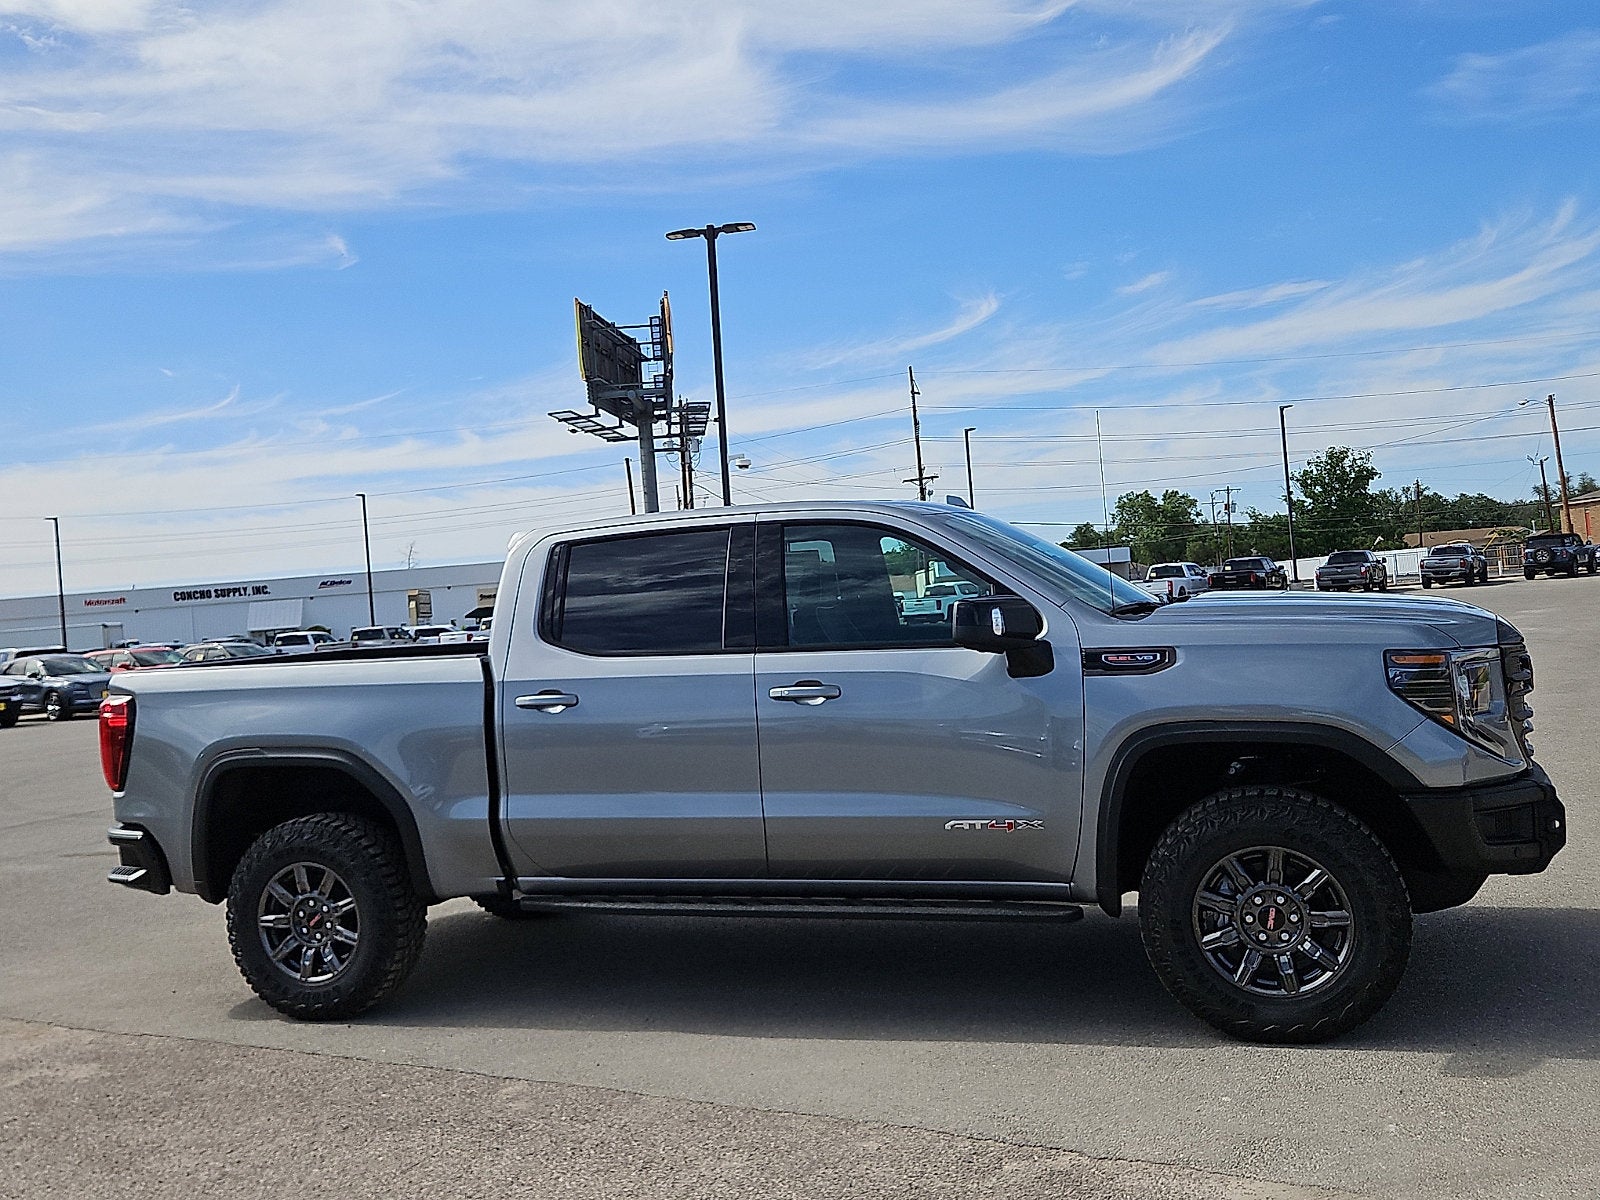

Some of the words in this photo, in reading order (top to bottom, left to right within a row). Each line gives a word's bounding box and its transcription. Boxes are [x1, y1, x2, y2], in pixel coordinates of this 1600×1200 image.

[173, 589, 212, 602] CONCHO
[213, 586, 251, 599] SUPPLY,
[251, 584, 271, 596] INC.
